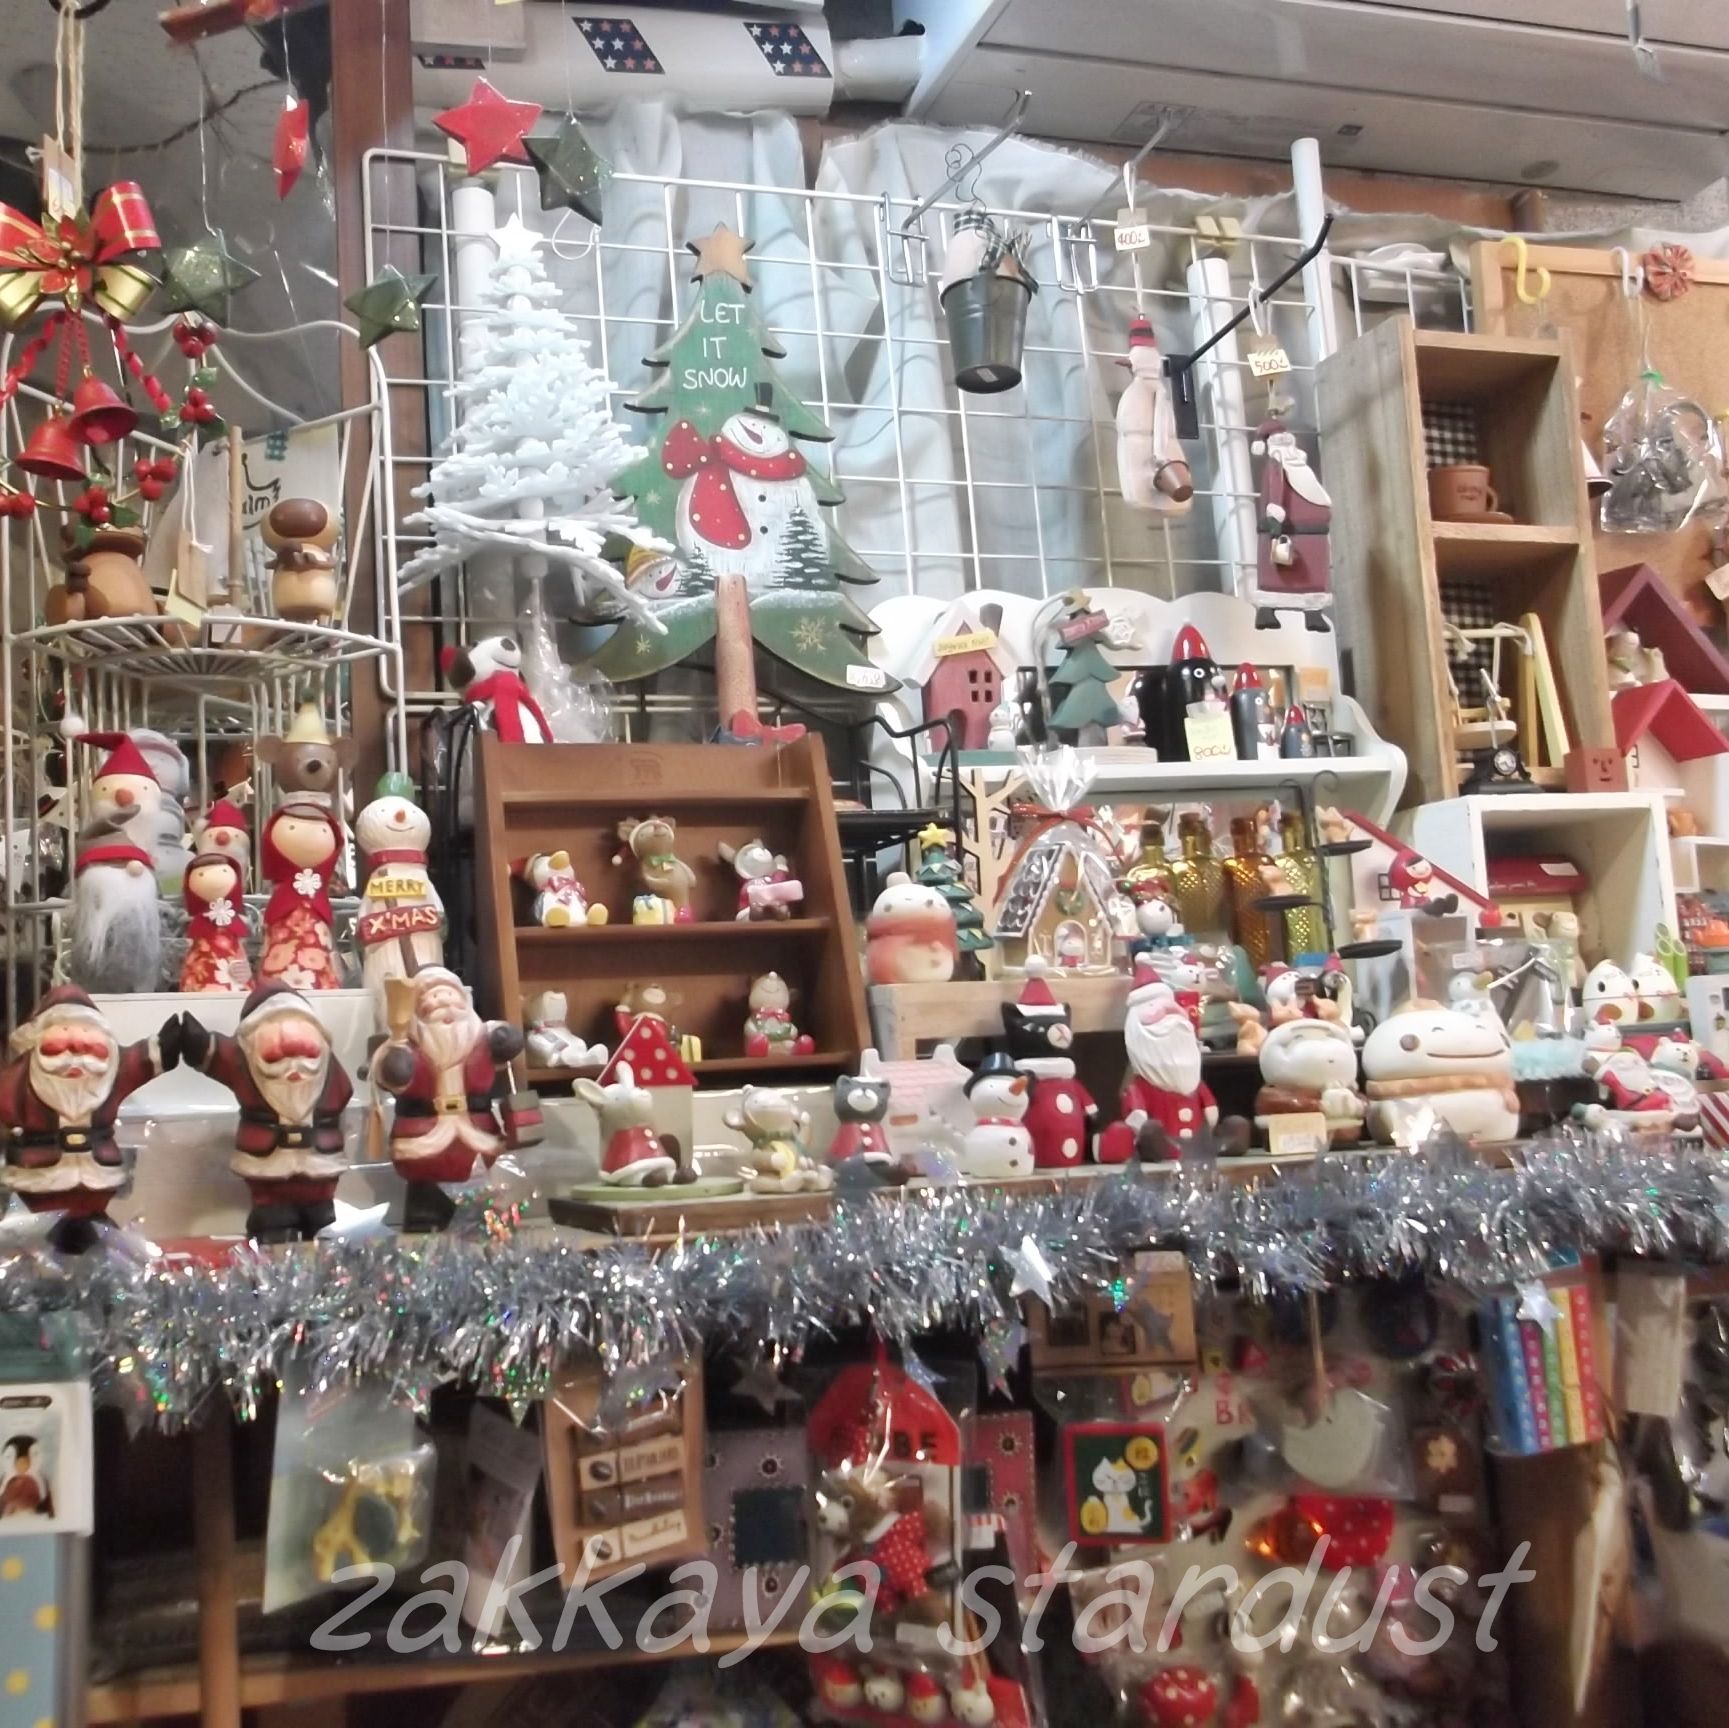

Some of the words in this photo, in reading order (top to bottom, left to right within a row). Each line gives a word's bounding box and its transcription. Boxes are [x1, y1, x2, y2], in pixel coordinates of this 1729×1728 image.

[700, 299, 745, 325] LET
[703, 337, 727, 359] IT
[682, 367, 748, 390] SNOW
[370, 880, 424, 895] MERRY
[369, 906, 438, 934] X'MAS
